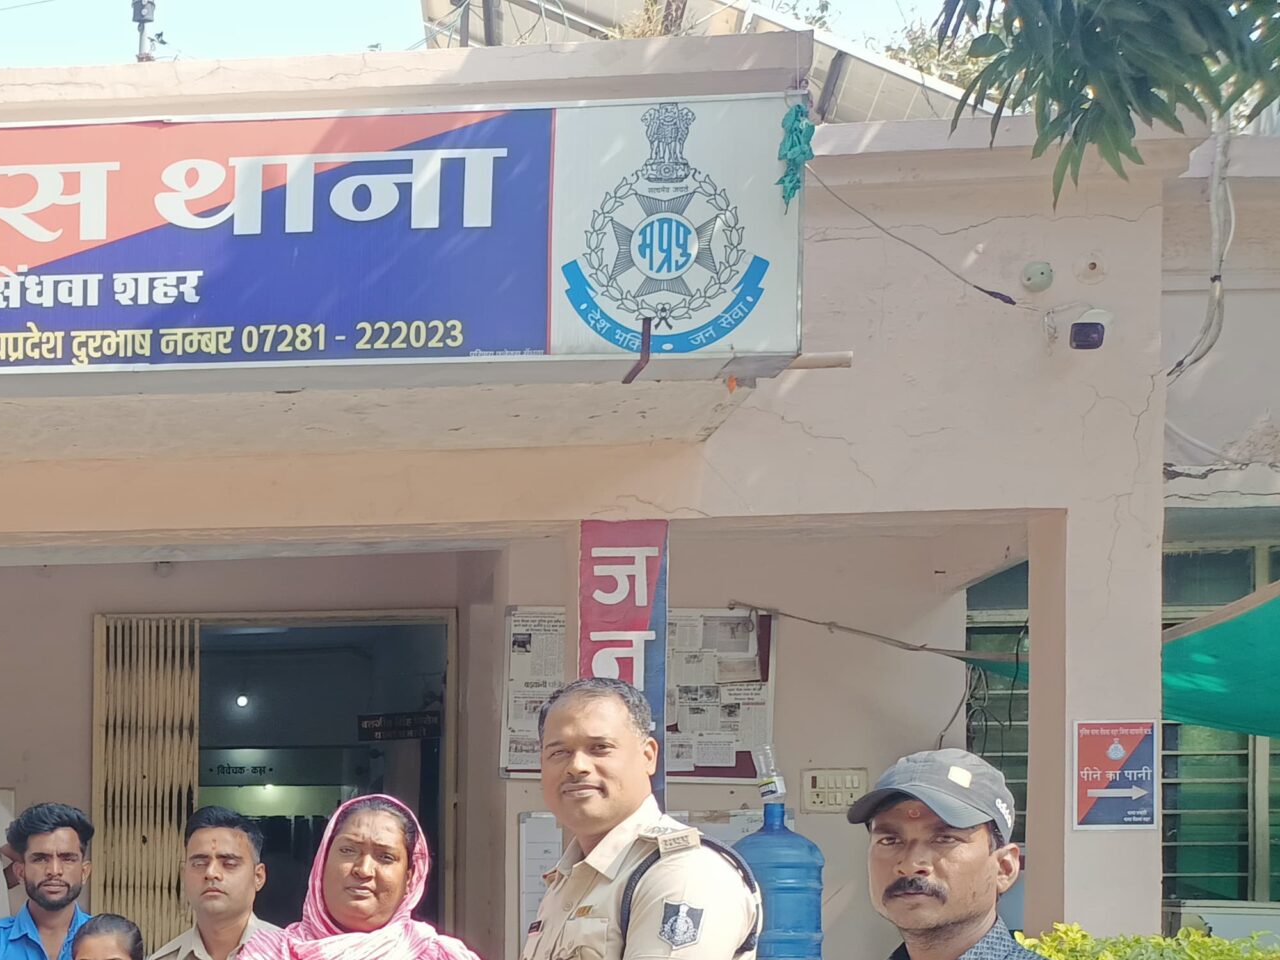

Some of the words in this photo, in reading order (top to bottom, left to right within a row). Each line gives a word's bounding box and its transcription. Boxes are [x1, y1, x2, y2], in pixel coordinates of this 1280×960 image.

[154, 147, 508, 236] थाना
[113, 270, 203, 305] शहर
[71, 329, 152, 366] दुरभाष
[159, 326, 234, 356] नम्बर
[241, 323, 326, 353] 07281
[355, 319, 463, 350] 222023
[587, 308, 612, 334] देश
[688, 326, 716, 345] जन
[719, 302, 748, 329] सेवा
[1080, 766, 1102, 782] पीने
[1105, 769, 1121, 782] का
[1124, 765, 1152, 781] पानी
